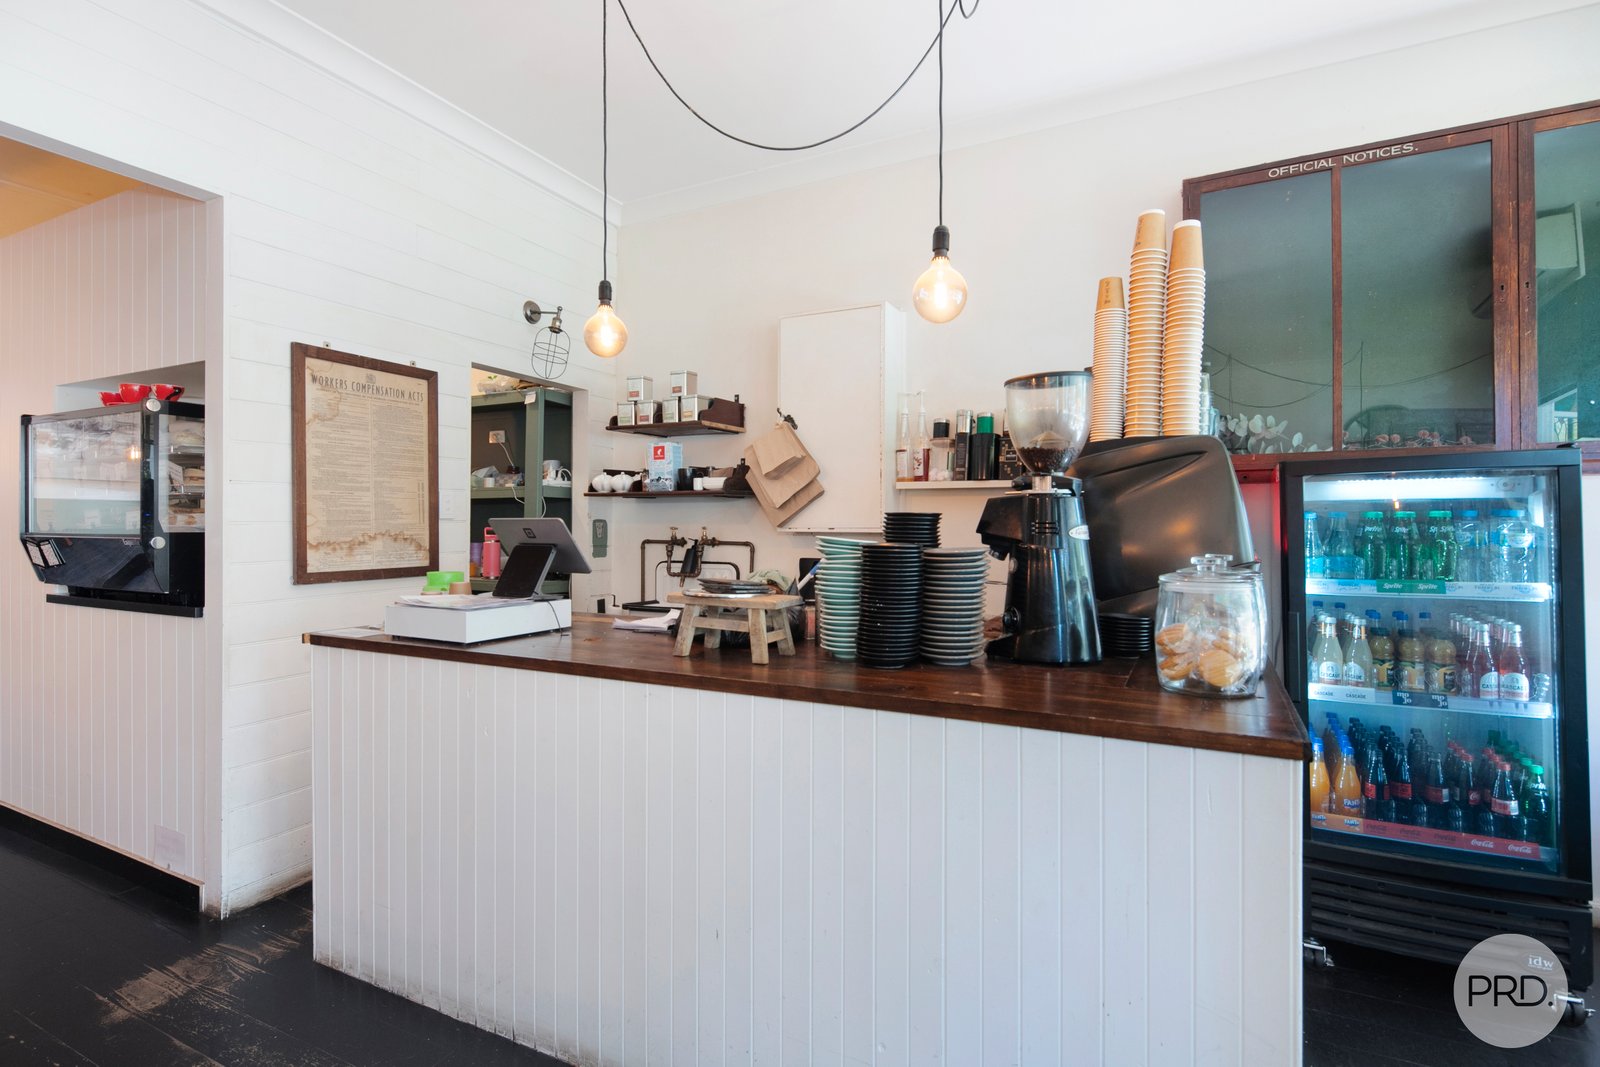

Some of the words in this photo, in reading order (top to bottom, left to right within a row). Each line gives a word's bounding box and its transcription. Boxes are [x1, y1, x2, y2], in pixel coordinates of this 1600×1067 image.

[1268, 156, 1337, 178] OFFICIAL
[1342, 142, 1419, 165] NOTICES.
[311, 373, 348, 390] WORKERS
[351, 381, 405, 400] COMPENSATION
[408, 391, 424, 402] ACTS
[1382, 582, 1403, 590] Sprite
